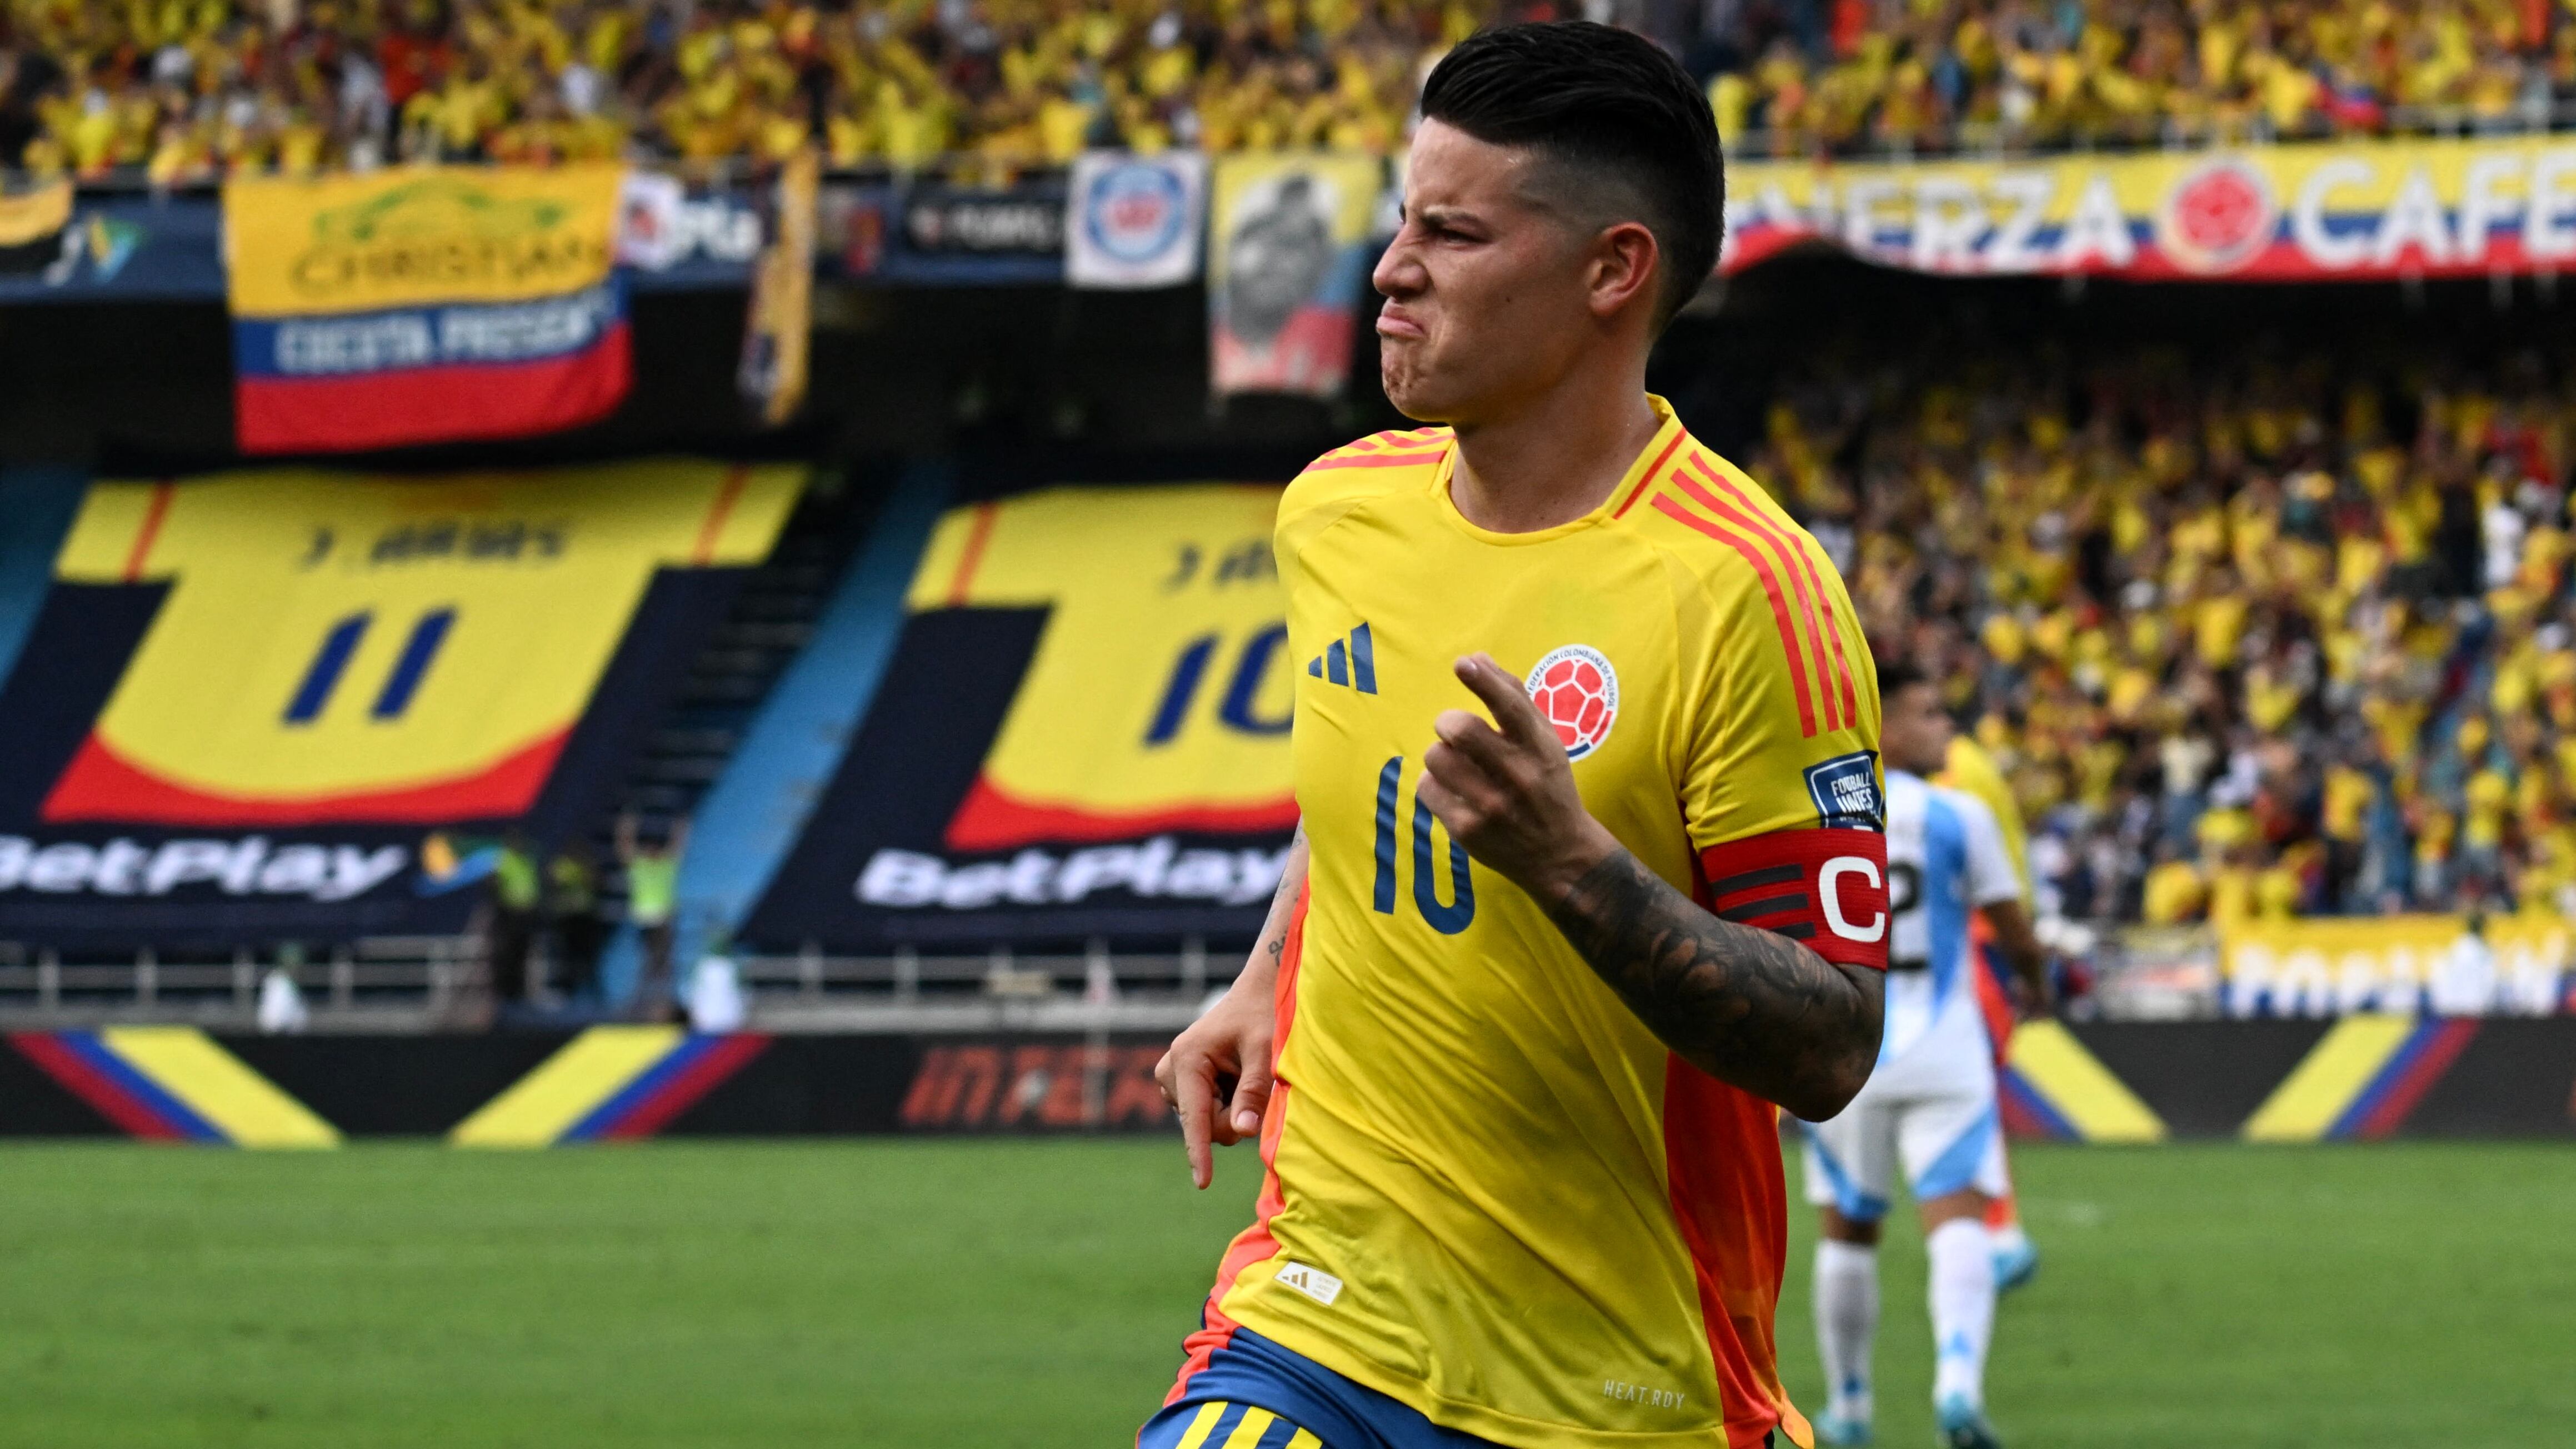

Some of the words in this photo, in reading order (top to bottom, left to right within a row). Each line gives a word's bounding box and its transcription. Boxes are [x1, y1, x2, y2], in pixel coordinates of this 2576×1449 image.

[279, 604, 459, 724] 11
[1143, 621, 1293, 748] 10
[854, 837, 1292, 908] BetPlay
[1373, 756, 1475, 935] 10
[1818, 856, 1885, 943] C
[1603, 1378, 1685, 1411] HEAT.RDY
